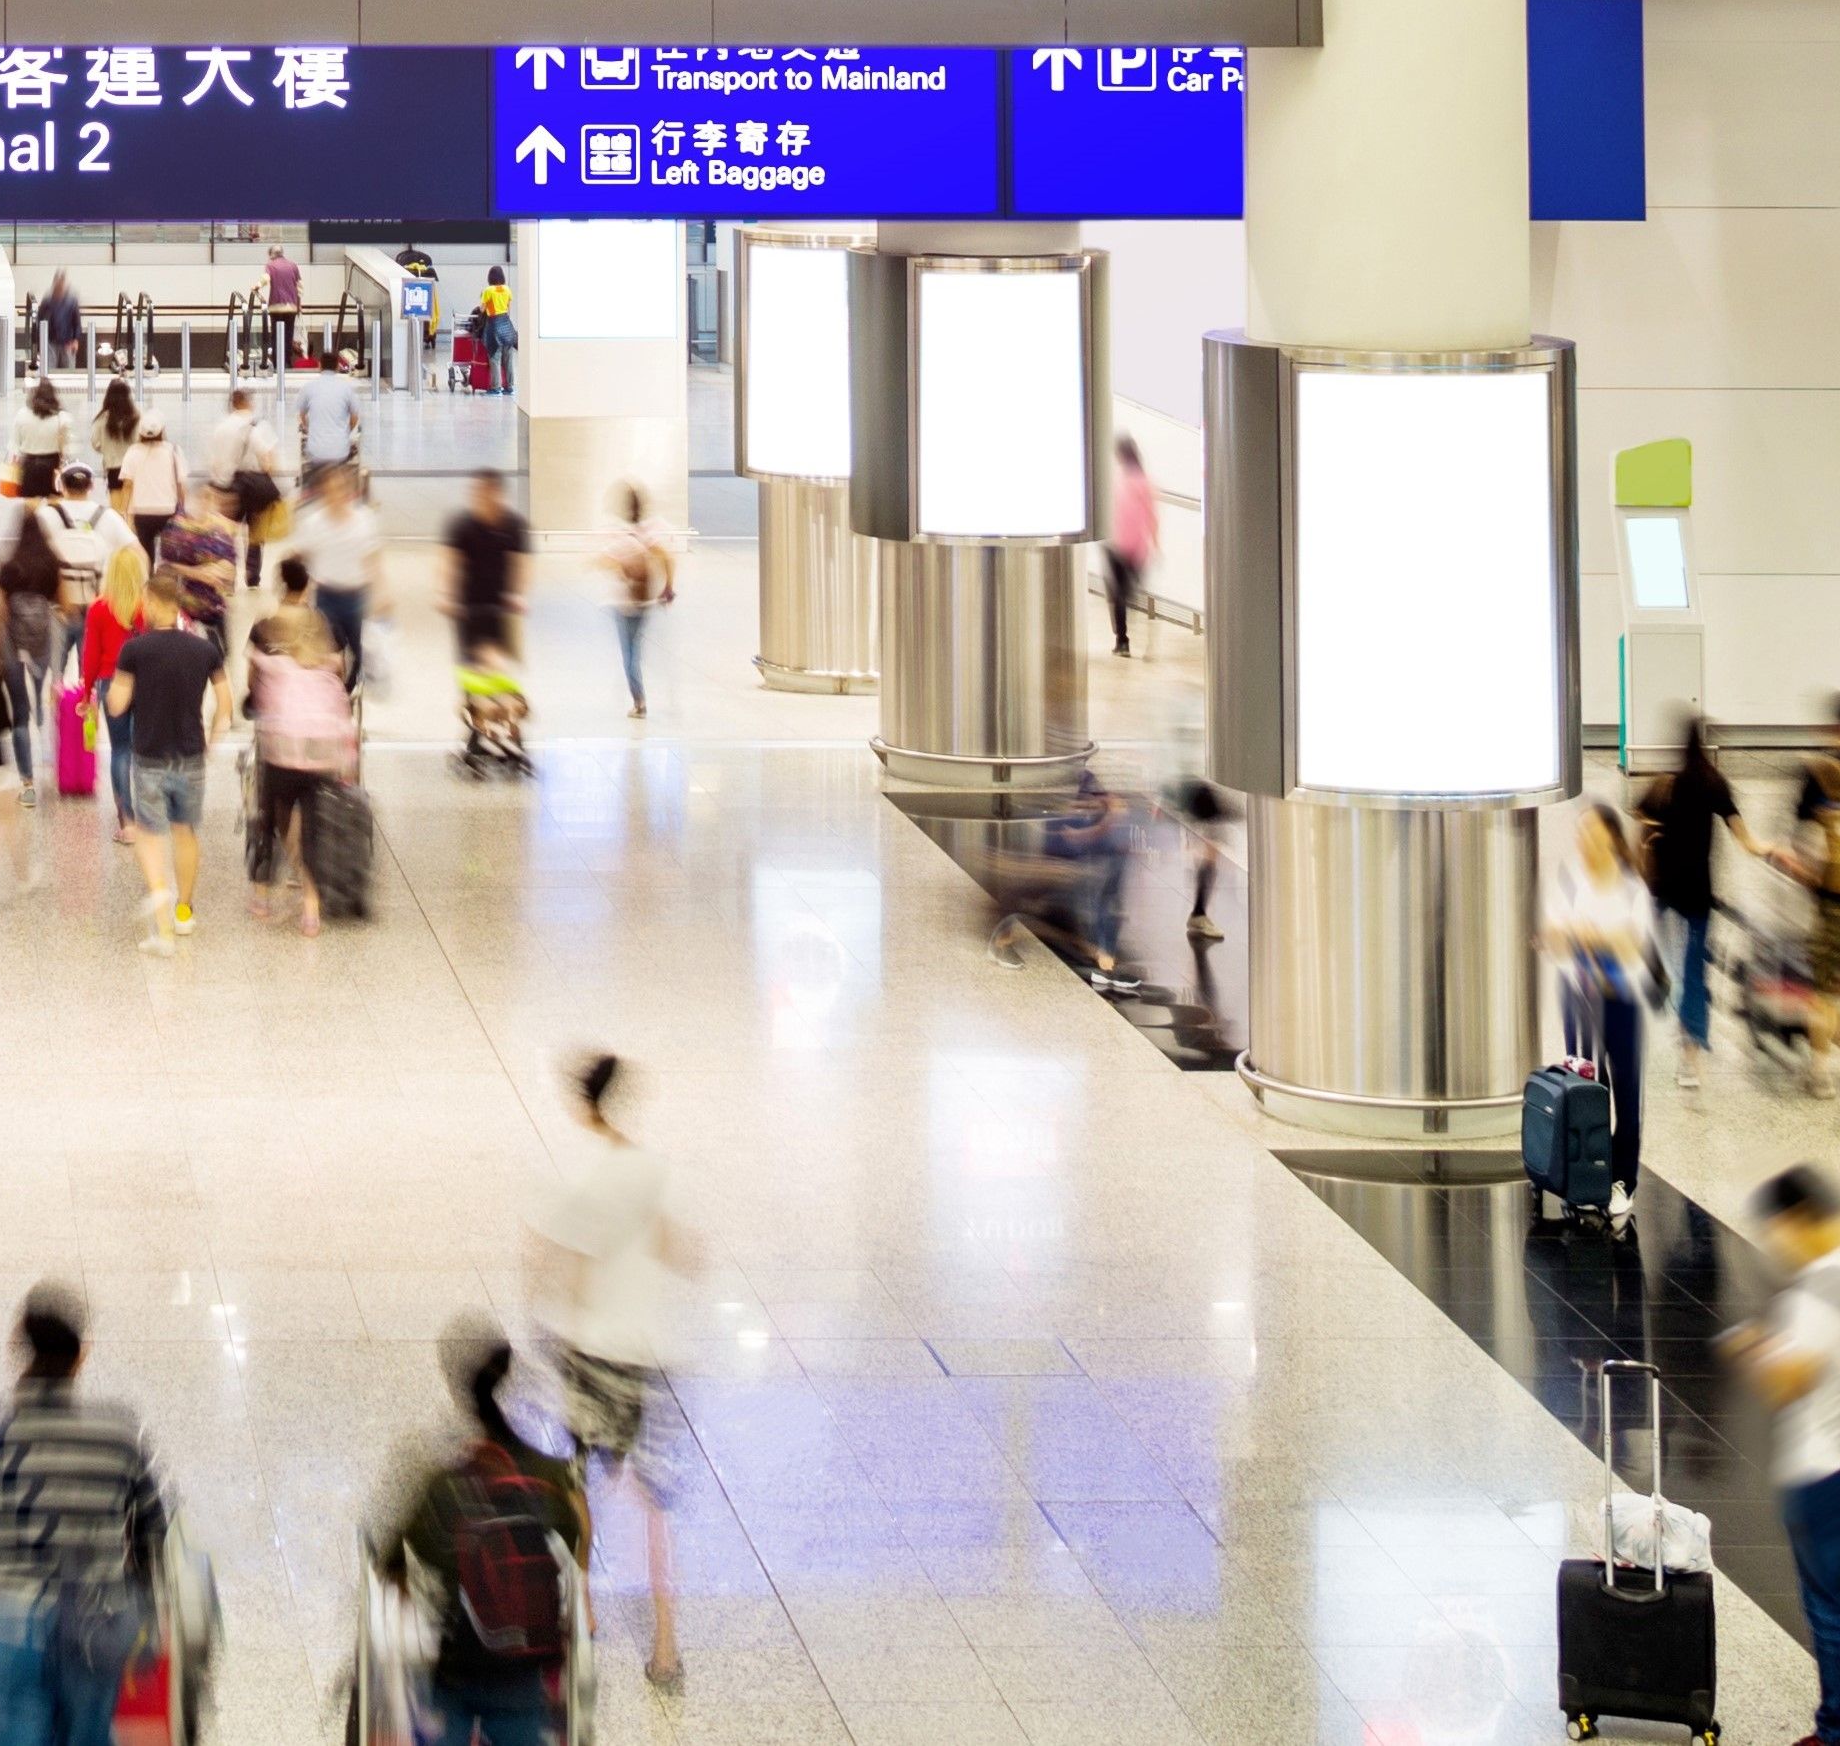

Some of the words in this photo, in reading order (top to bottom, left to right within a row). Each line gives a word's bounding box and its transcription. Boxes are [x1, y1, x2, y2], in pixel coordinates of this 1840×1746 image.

[651, 65, 778, 95] Transport
[785, 68, 813, 90] to
[822, 65, 946, 91] Mainland
[1167, 66, 1214, 92] Car
[78, 122, 111, 172] 2
[651, 120, 811, 156] 行李寄存
[651, 159, 700, 185] Left
[708, 159, 826, 191] Baggage
